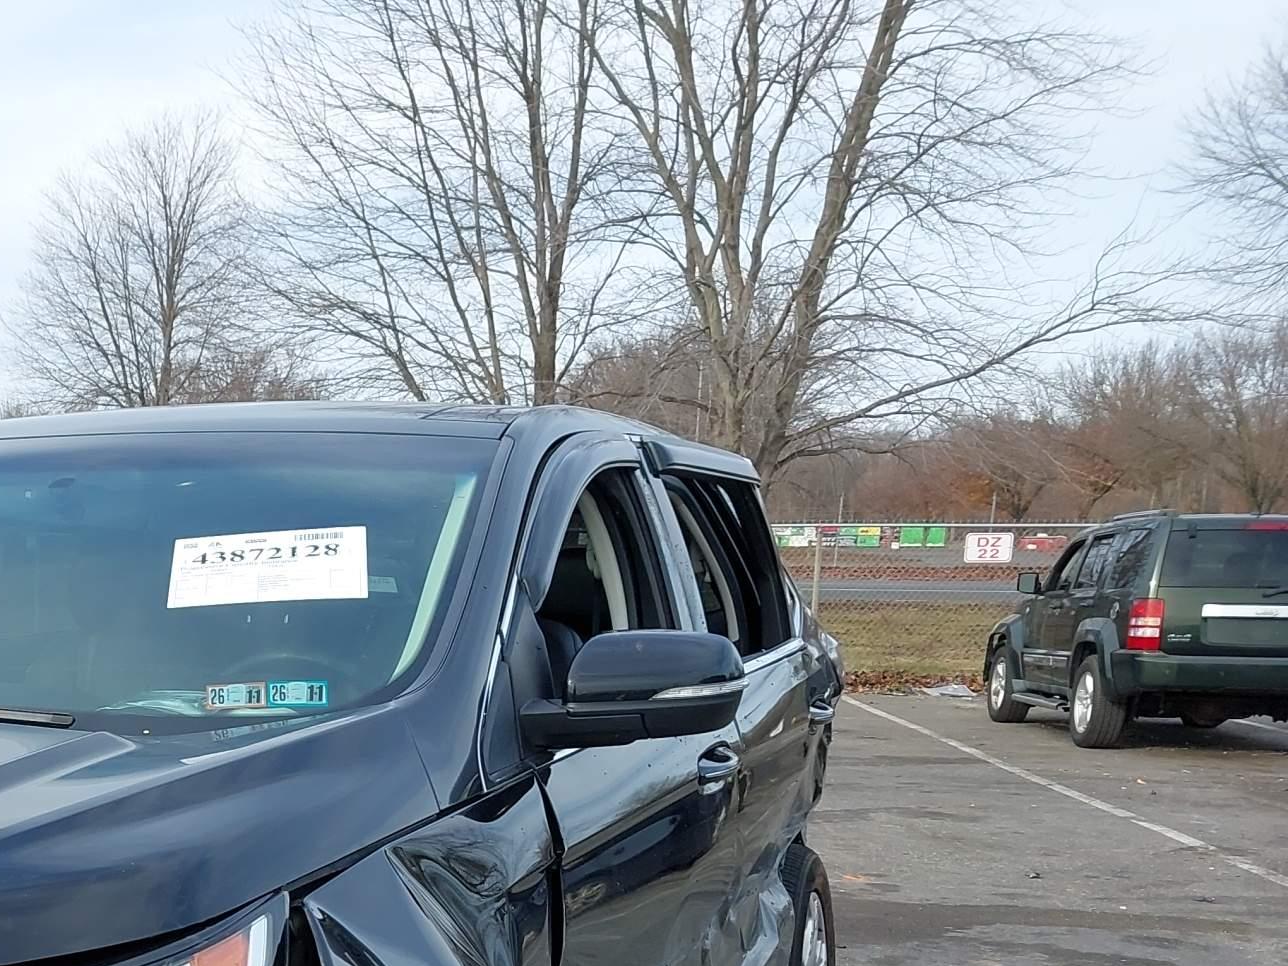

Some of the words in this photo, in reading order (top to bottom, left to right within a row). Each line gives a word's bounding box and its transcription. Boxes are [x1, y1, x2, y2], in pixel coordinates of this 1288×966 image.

[977, 537, 1002, 547] DZ
[192, 543, 341, 565] 43872128
[977, 549, 999, 558] 22
[210, 688, 225, 705] 26
[271, 684, 286, 702] 26
